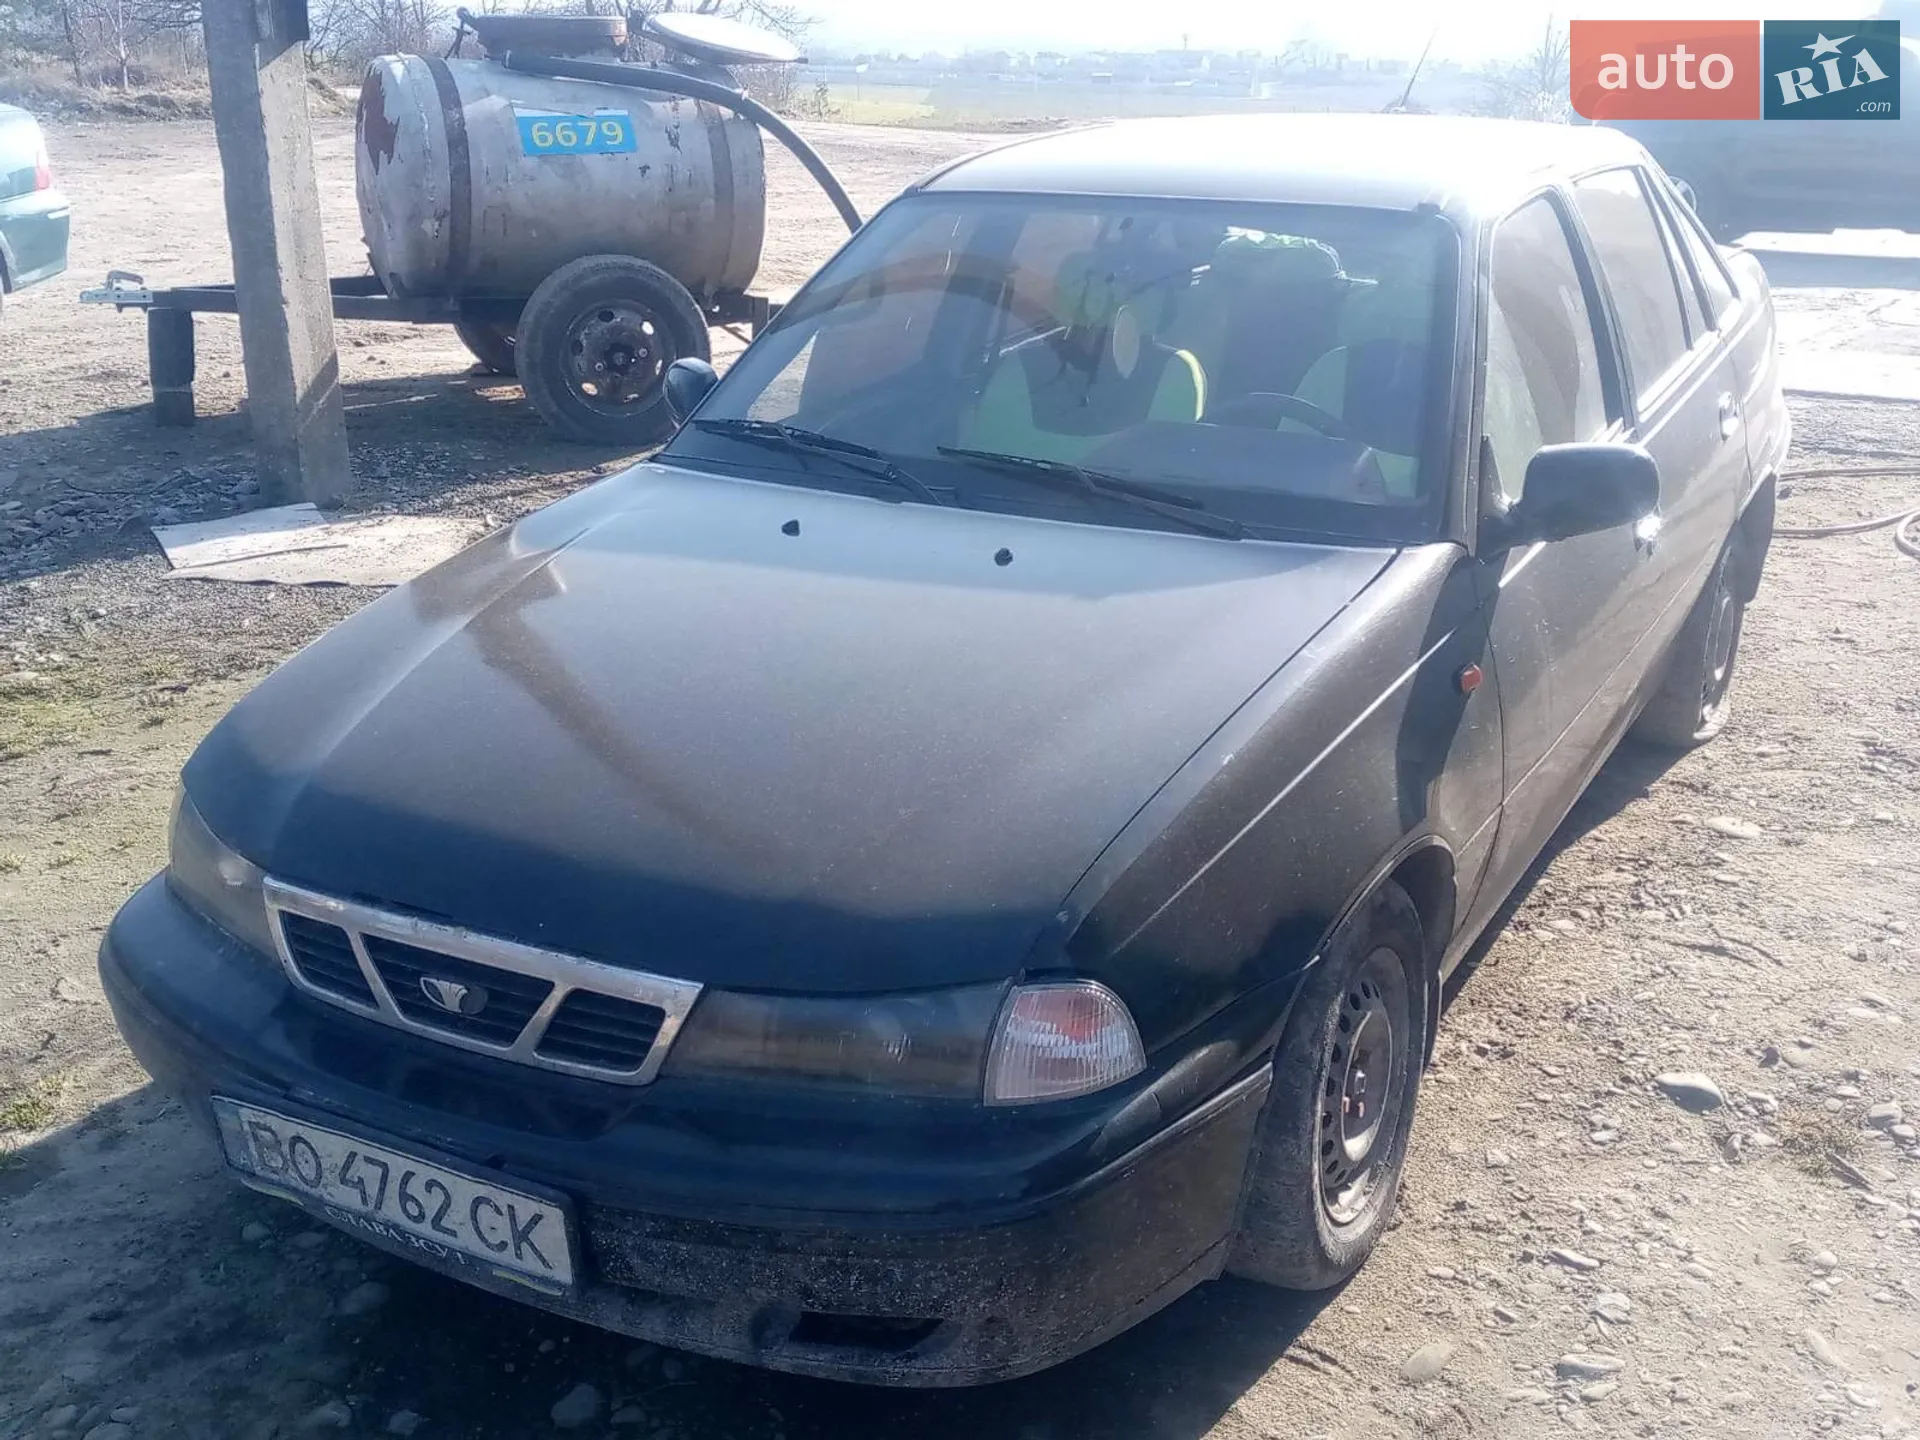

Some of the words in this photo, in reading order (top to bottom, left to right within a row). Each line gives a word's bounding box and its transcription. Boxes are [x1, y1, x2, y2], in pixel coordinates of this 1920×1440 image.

[531, 121, 624, 148] 6679
[248, 1120, 323, 1188] BO
[338, 1150, 458, 1238] 4762
[470, 1195, 553, 1270] CK
